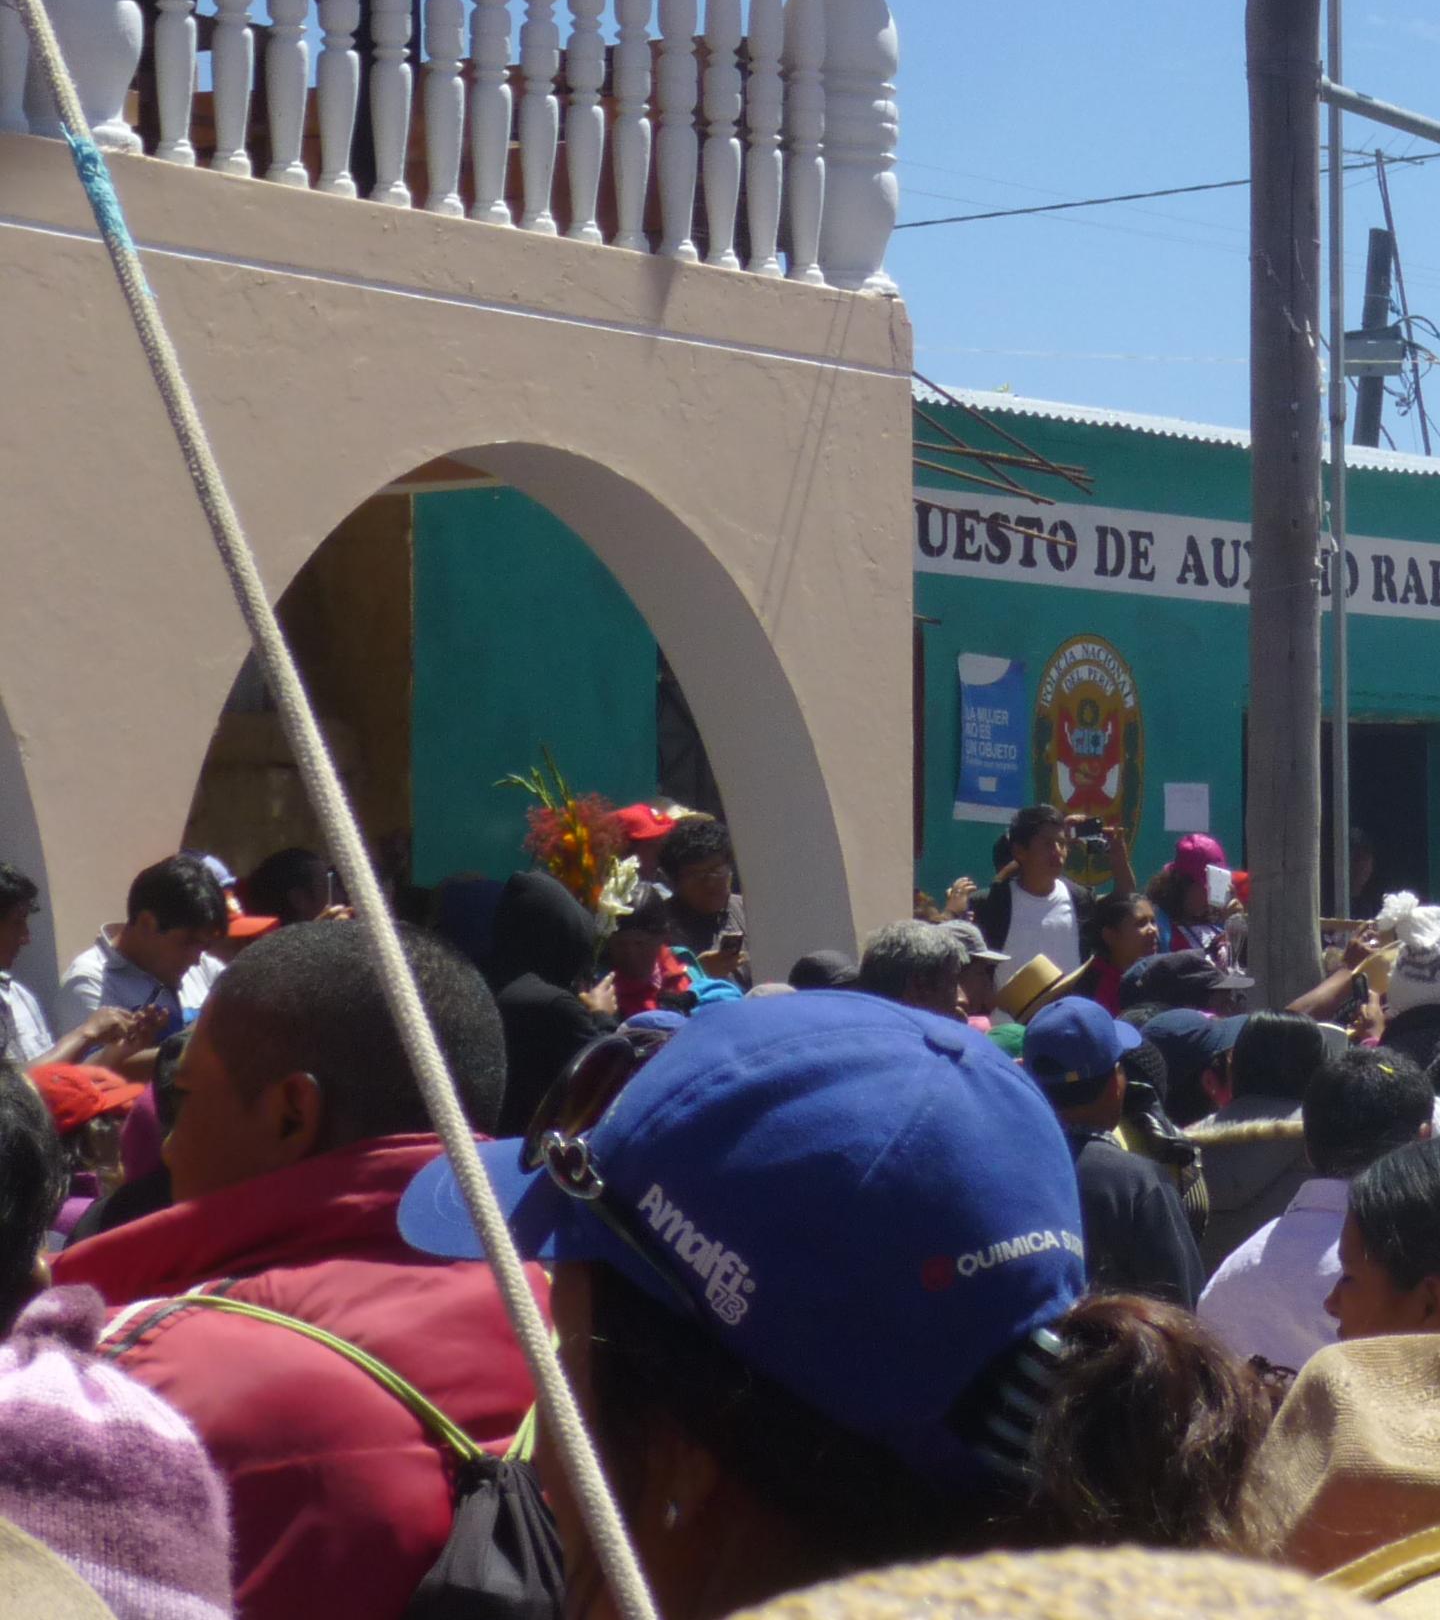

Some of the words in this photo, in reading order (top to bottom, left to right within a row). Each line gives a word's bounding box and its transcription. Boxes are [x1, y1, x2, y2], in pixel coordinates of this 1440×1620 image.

[915, 502, 1077, 572] UESTO
[1094, 525, 1156, 581] DE
[979, 741, 1017, 760] OBJETO
[957, 1230, 1060, 1276] QUIMICA
